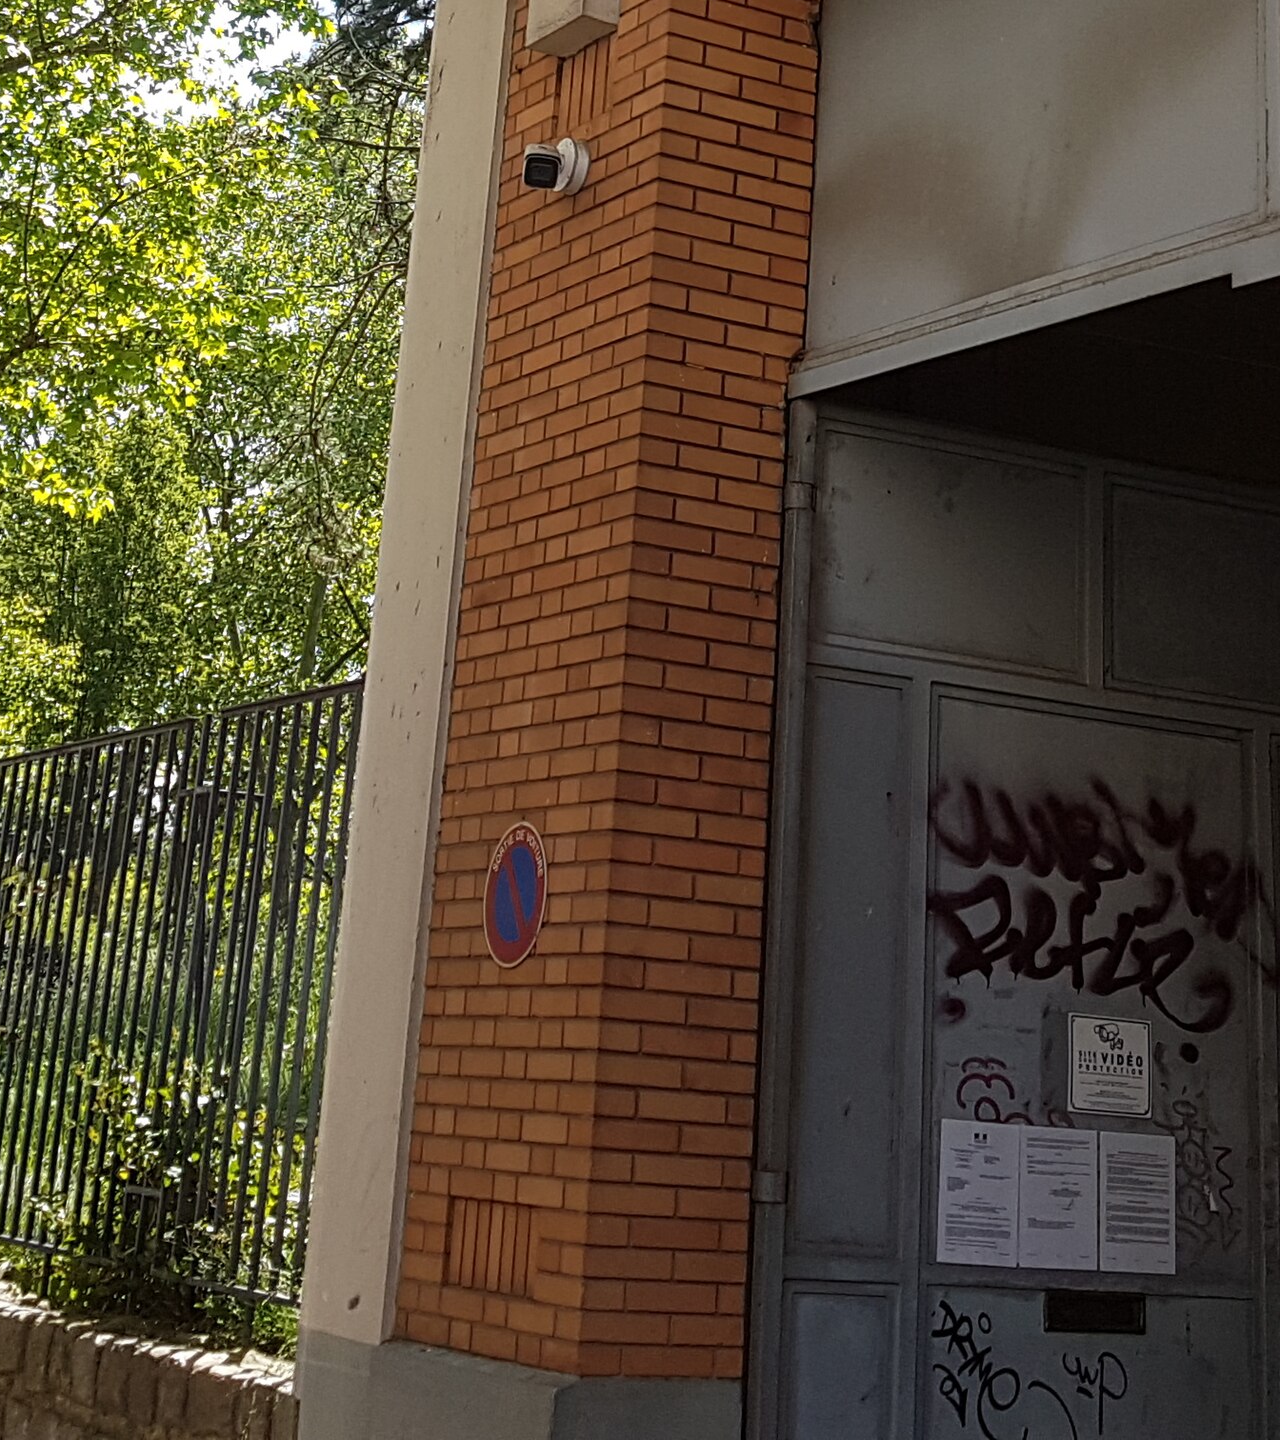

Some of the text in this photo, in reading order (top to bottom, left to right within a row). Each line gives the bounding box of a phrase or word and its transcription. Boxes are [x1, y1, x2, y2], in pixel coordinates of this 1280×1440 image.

[516, 830, 525, 841] DE
[1101, 1051, 1143, 1067] VIDÉO
[1078, 1063, 1143, 1076] PROTECTION
